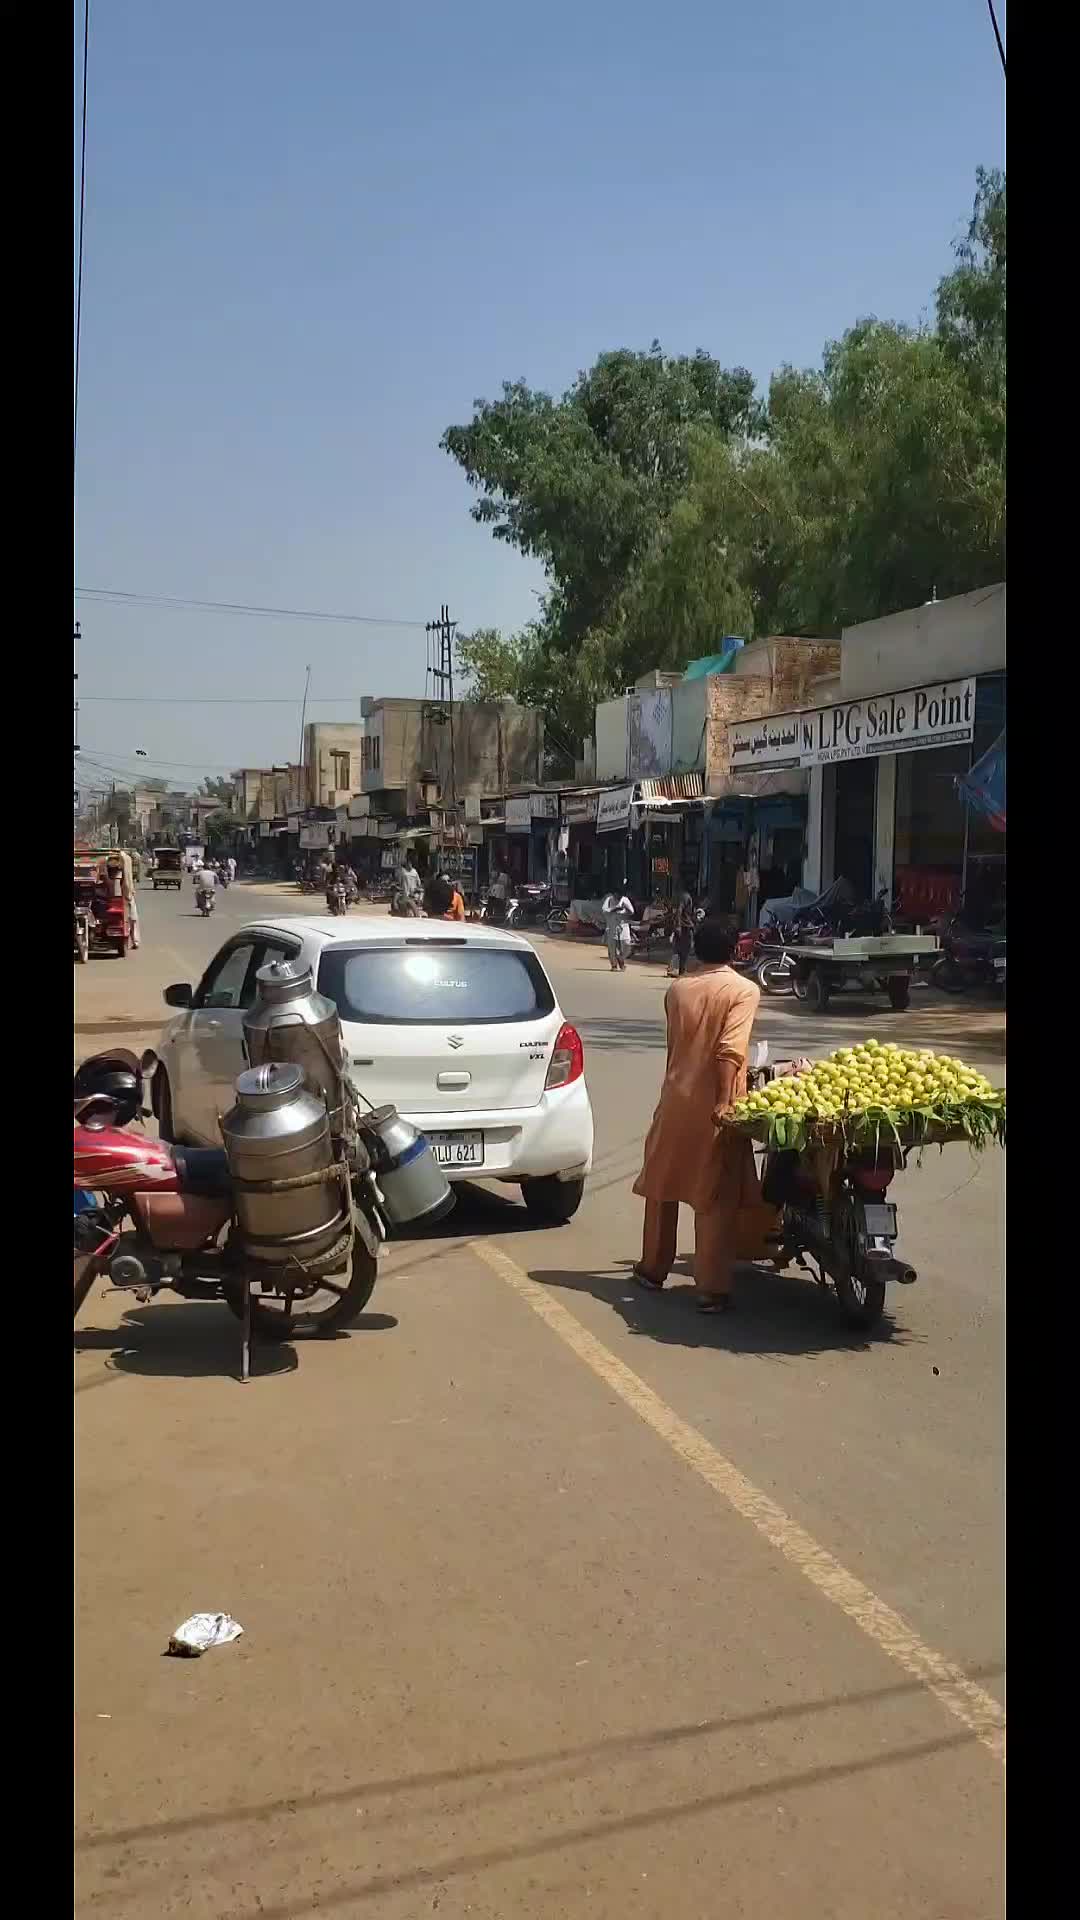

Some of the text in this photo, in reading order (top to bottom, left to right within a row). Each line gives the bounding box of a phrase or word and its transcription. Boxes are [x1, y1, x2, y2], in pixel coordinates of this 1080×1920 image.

[818, 684, 973, 749] LPG Sale Point
[519, 1040, 549, 1049] CULTUS
[529, 1053, 545, 1061] VXL
[457, 1144, 476, 1161] 621
